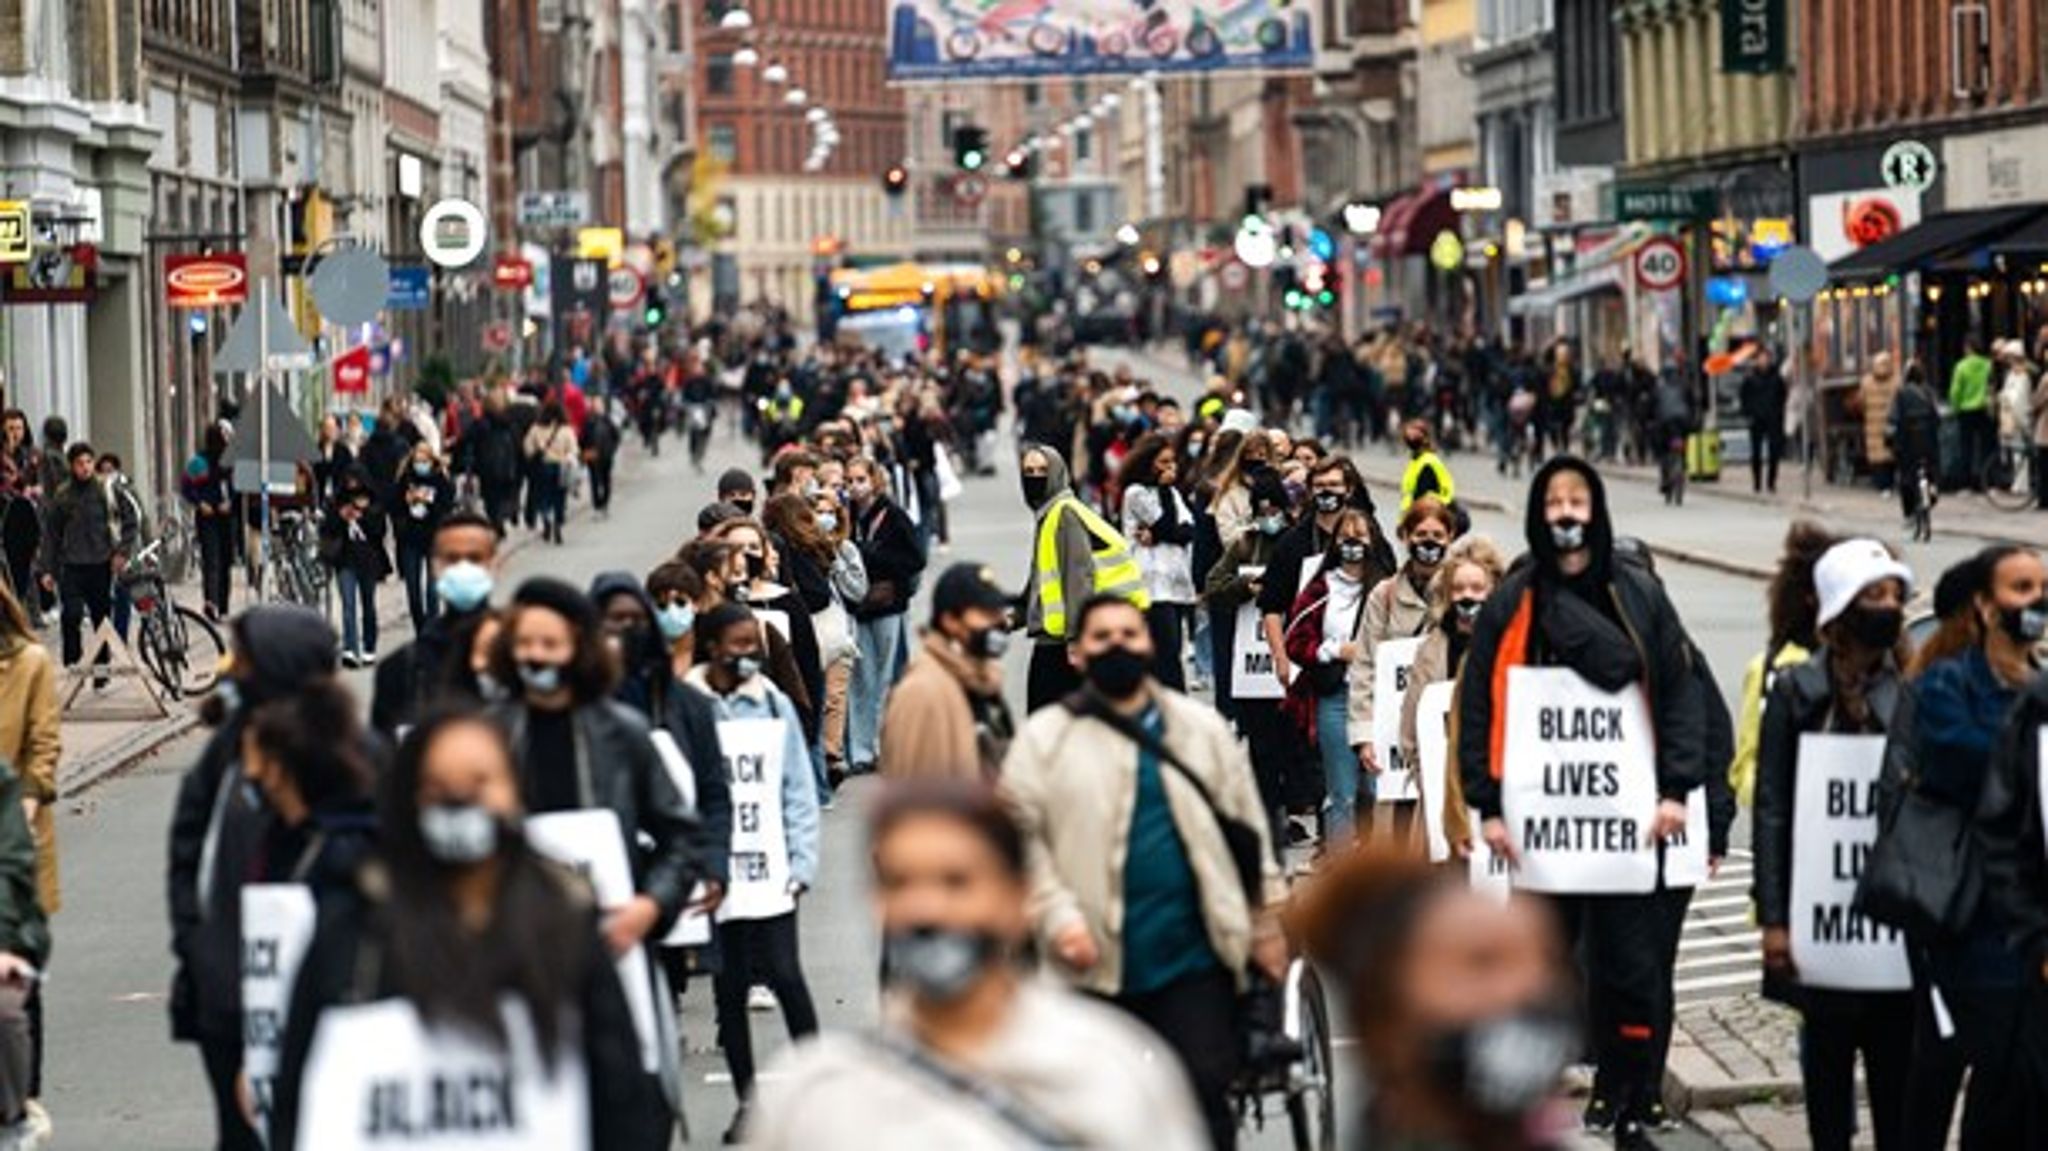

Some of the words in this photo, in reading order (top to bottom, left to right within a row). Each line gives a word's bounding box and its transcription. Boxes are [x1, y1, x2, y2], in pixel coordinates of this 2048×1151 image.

[1624, 194, 1694, 213] HOTEL
[1644, 254, 1676, 274] 40
[1539, 706, 1624, 742] BLACK
[1543, 762, 1619, 796] LIVES
[1523, 816, 1637, 852] MATTER
[1834, 842, 1874, 881] LI
